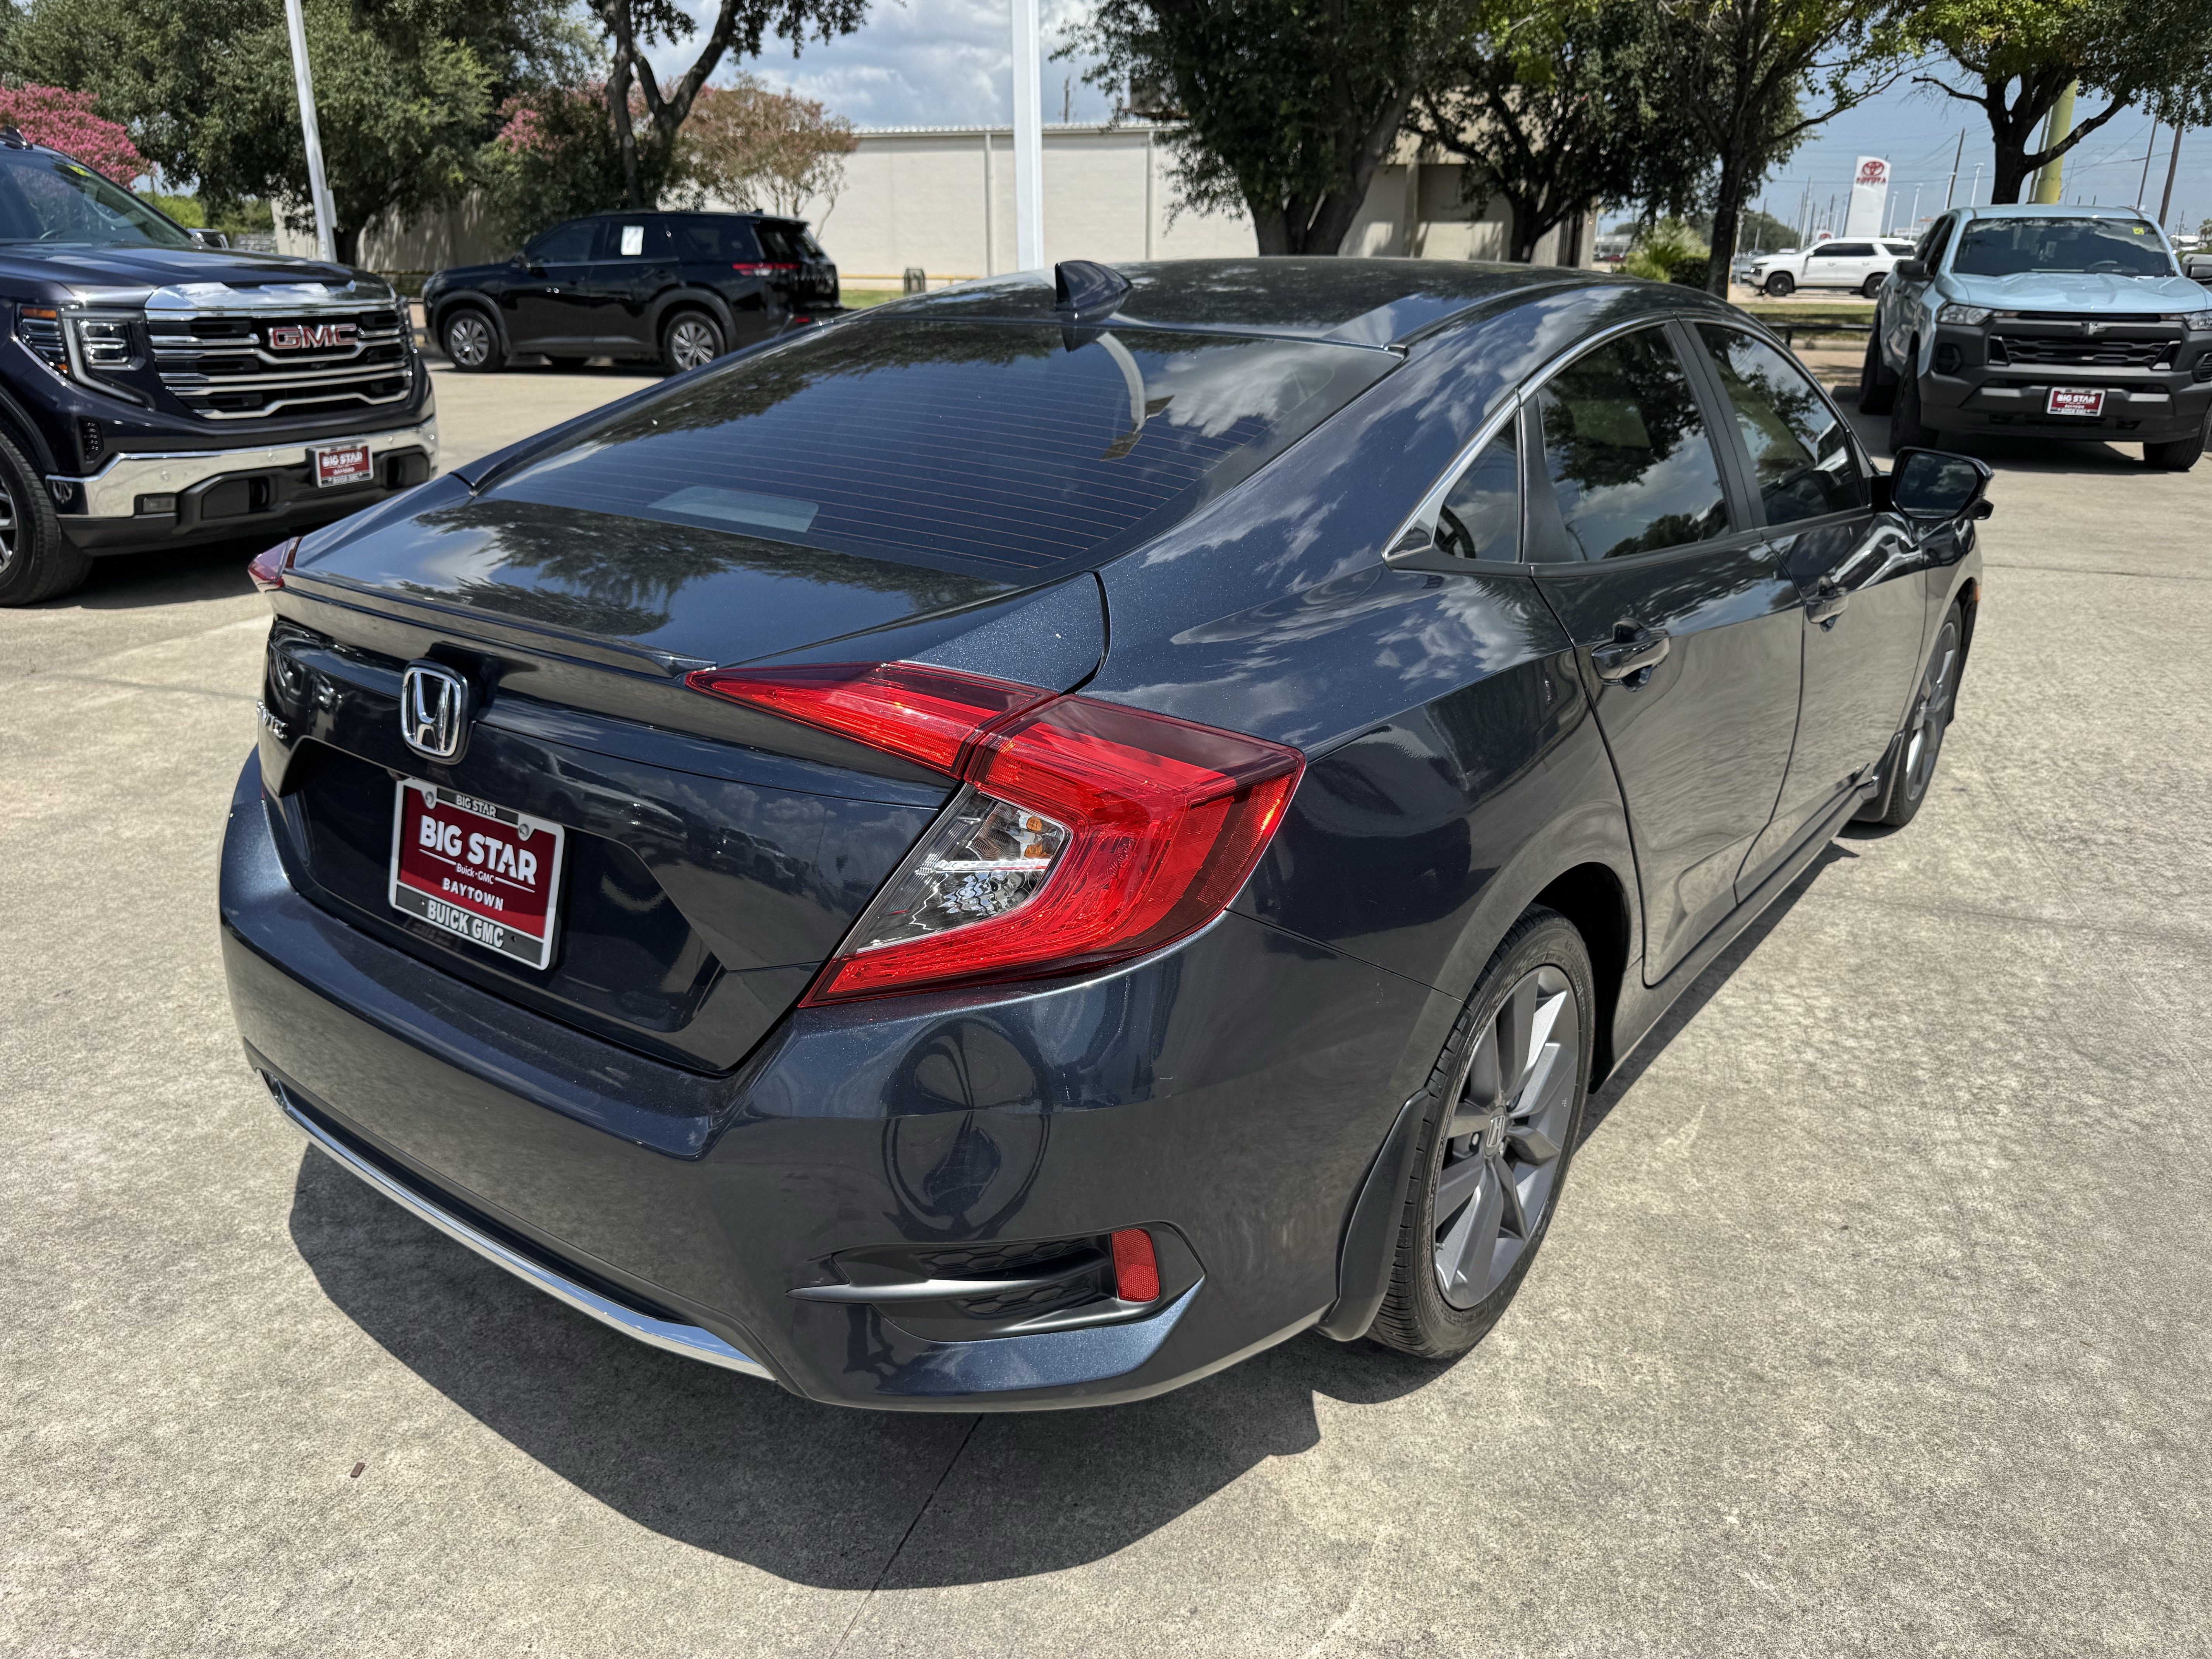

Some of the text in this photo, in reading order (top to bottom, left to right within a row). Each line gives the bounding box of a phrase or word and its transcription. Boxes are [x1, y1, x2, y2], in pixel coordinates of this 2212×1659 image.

[1856, 176, 1886, 185] TOYOTA
[268, 323, 358, 349] GMC
[2057, 394, 2096, 403] BIG STAR
[322, 452, 363, 467] BIG STAR
[456, 794, 496, 817] BIG STAR
[419, 815, 537, 885] BIG STAR
[442, 877, 503, 911] BAYTOWN
[428, 900, 504, 948] BUICK GMC
